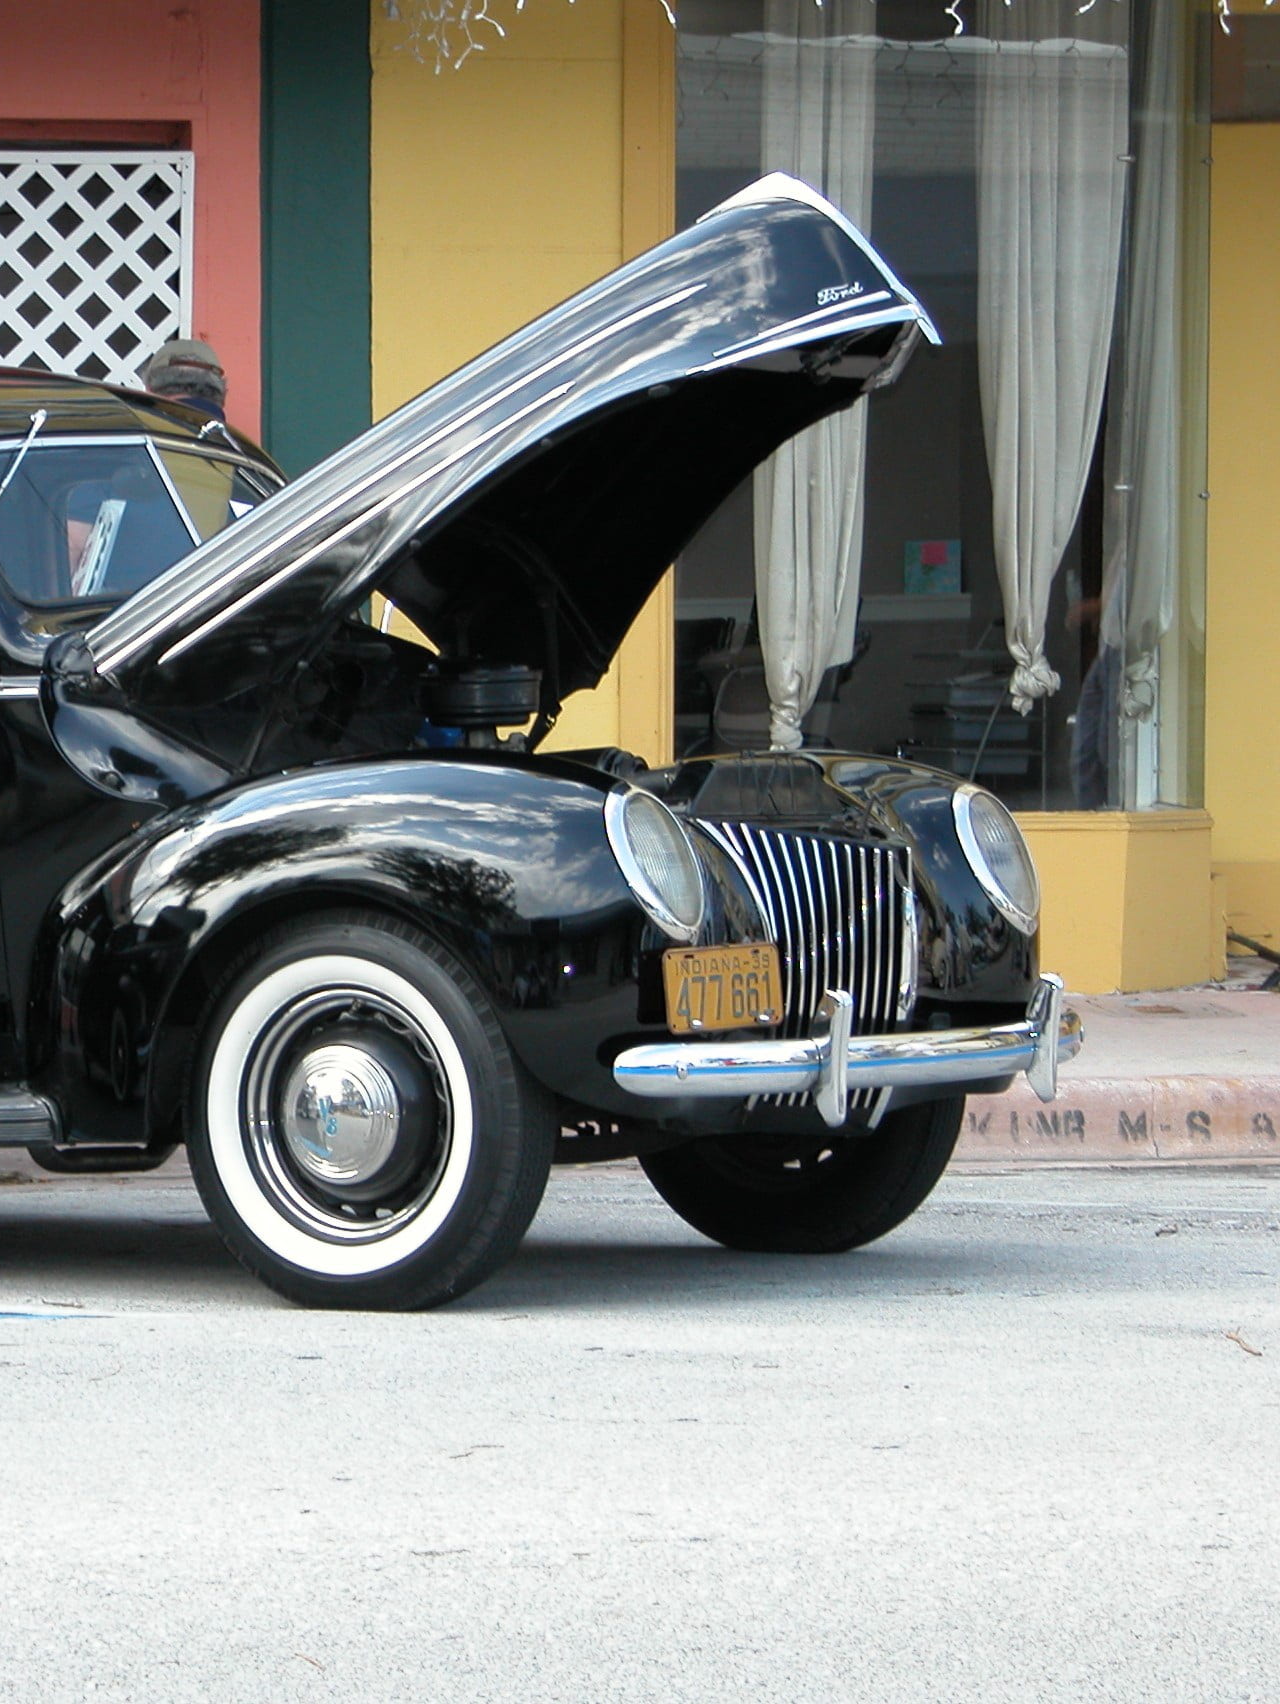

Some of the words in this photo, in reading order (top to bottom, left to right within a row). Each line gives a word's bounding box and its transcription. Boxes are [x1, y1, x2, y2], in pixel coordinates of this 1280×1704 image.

[817, 281, 864, 305] Ford
[677, 974, 723, 1030] 477
[732, 971, 775, 1021] 661
